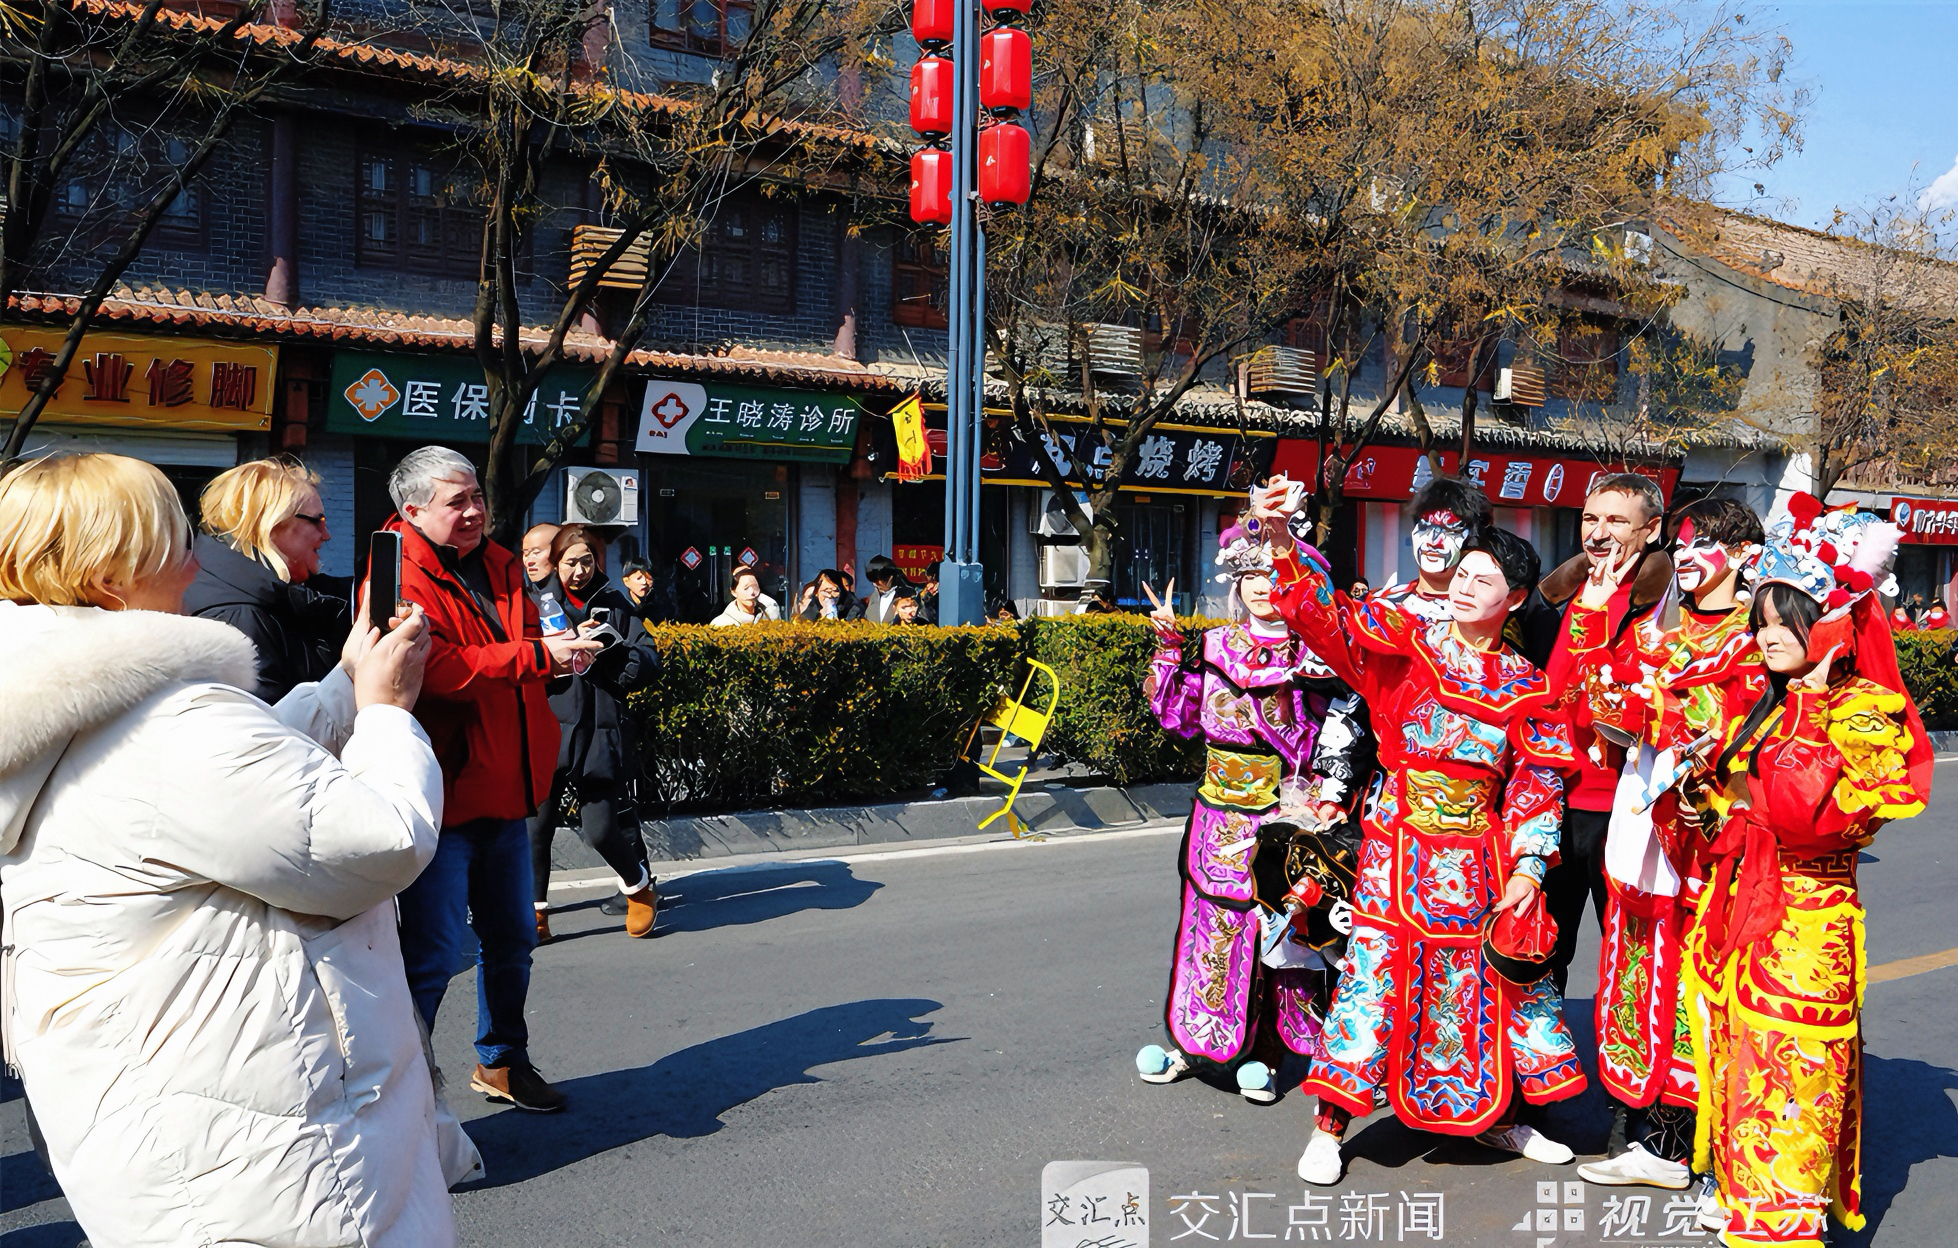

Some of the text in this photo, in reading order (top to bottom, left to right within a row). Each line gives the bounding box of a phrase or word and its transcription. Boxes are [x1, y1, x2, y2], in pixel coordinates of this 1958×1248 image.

[704, 398, 856, 435] 王晓涛诊所
